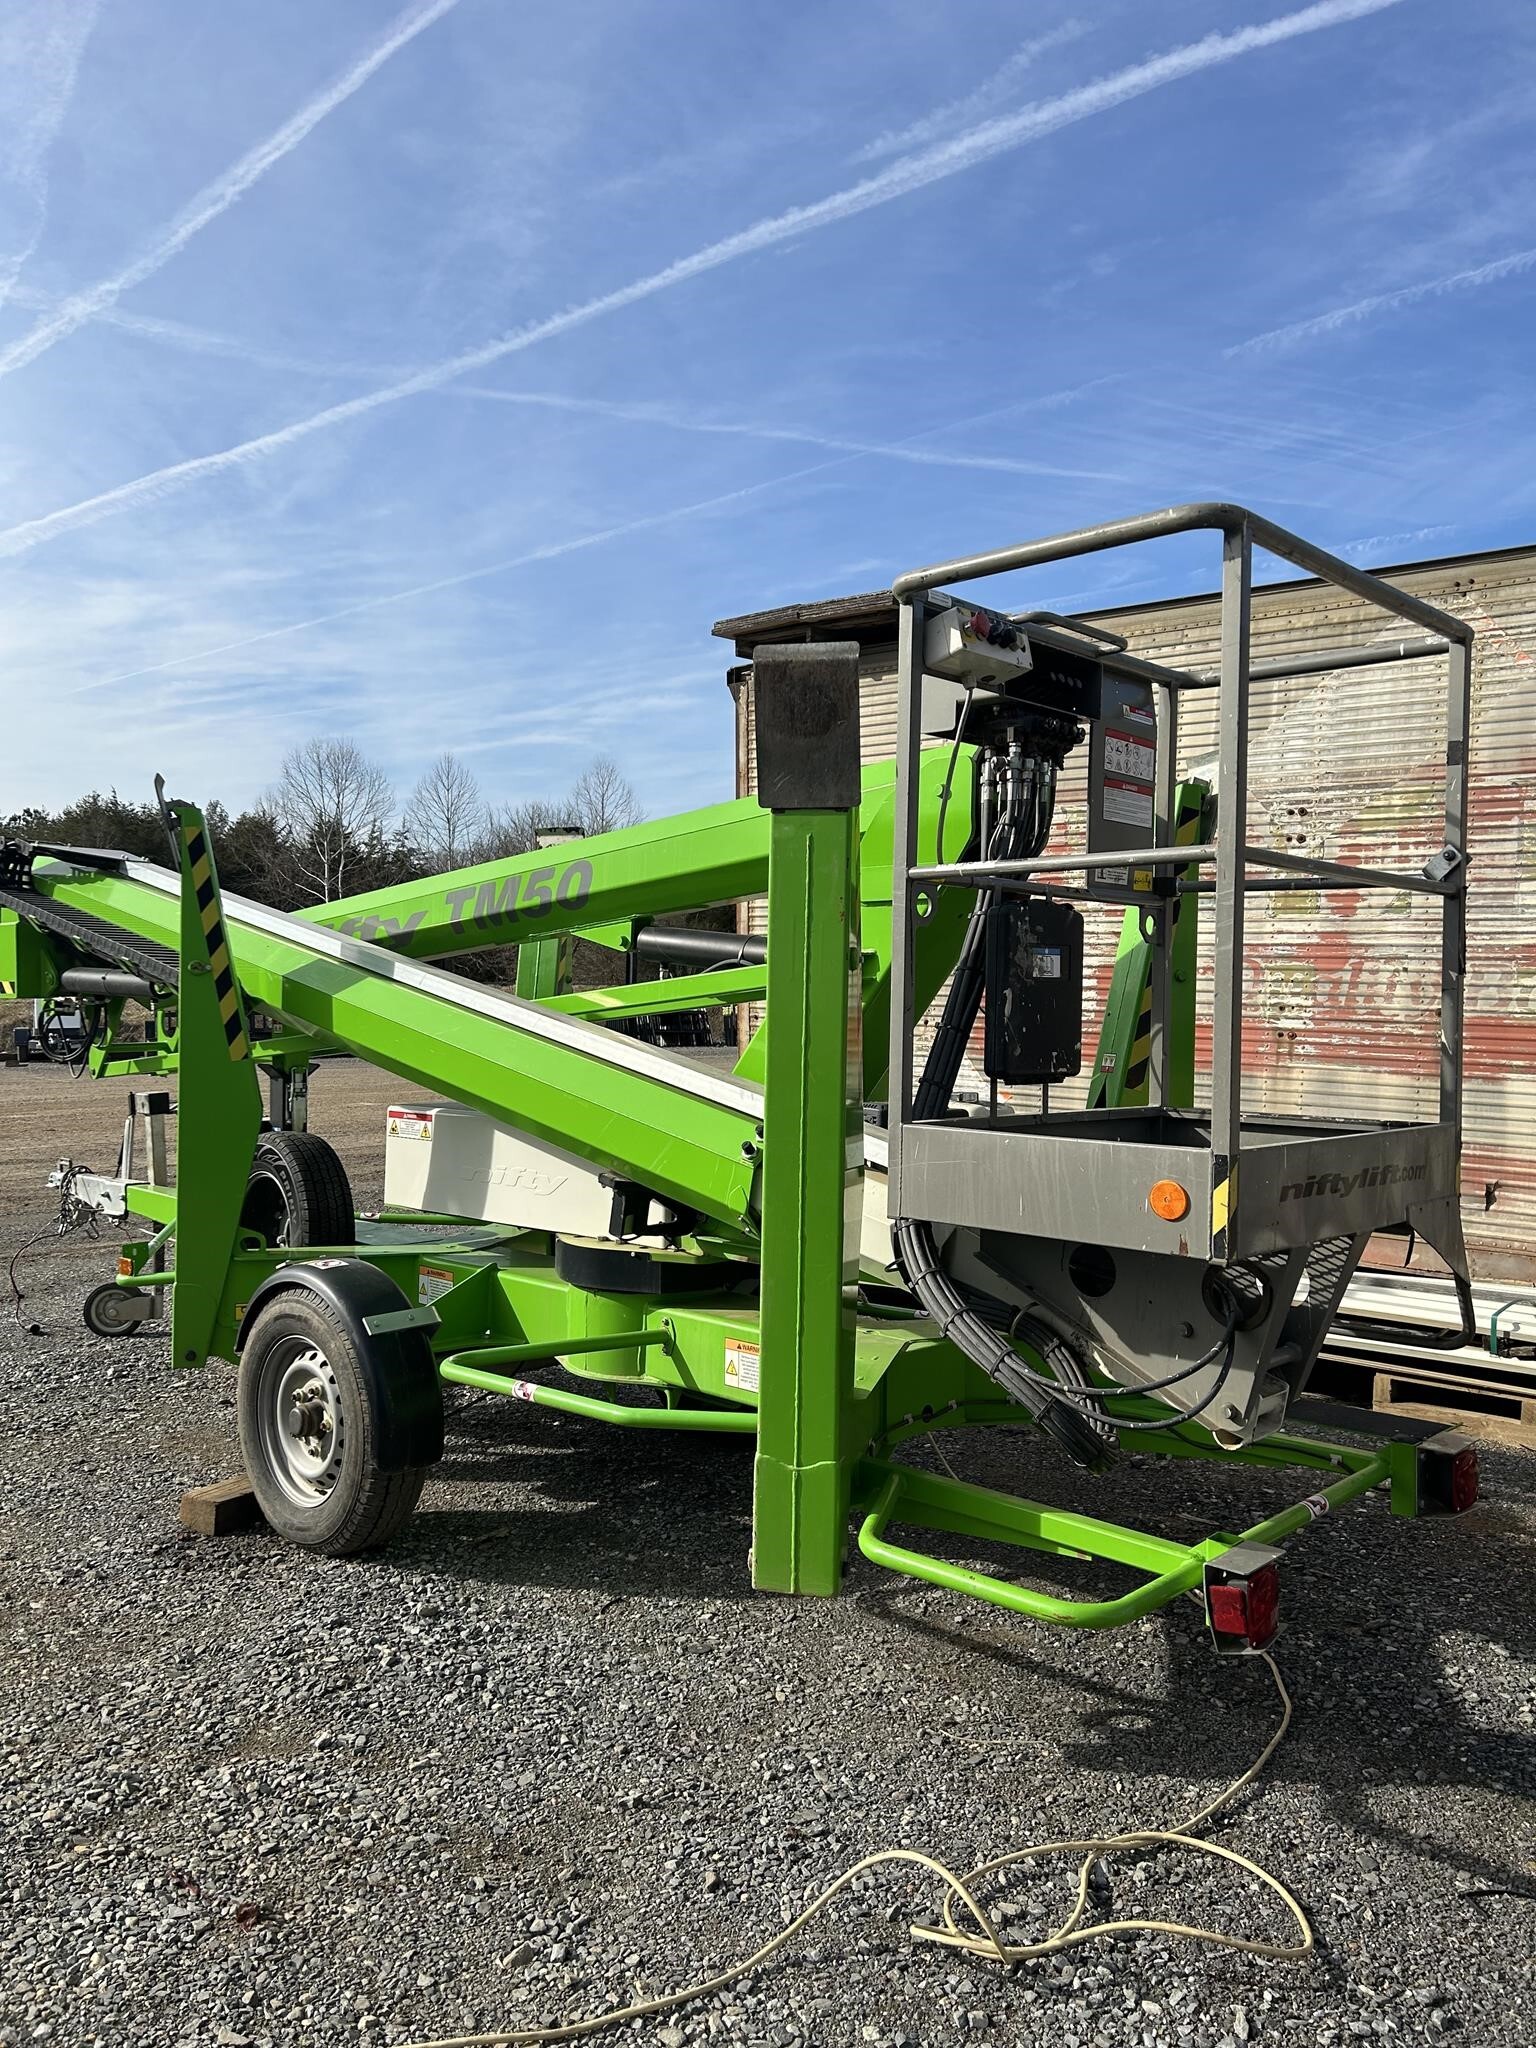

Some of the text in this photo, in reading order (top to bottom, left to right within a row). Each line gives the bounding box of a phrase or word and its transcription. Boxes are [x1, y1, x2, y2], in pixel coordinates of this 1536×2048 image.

[446, 860, 593, 934] TM50
[462, 1166, 569, 1196] nifty
[1279, 1164, 1426, 1202] niftylift.com
